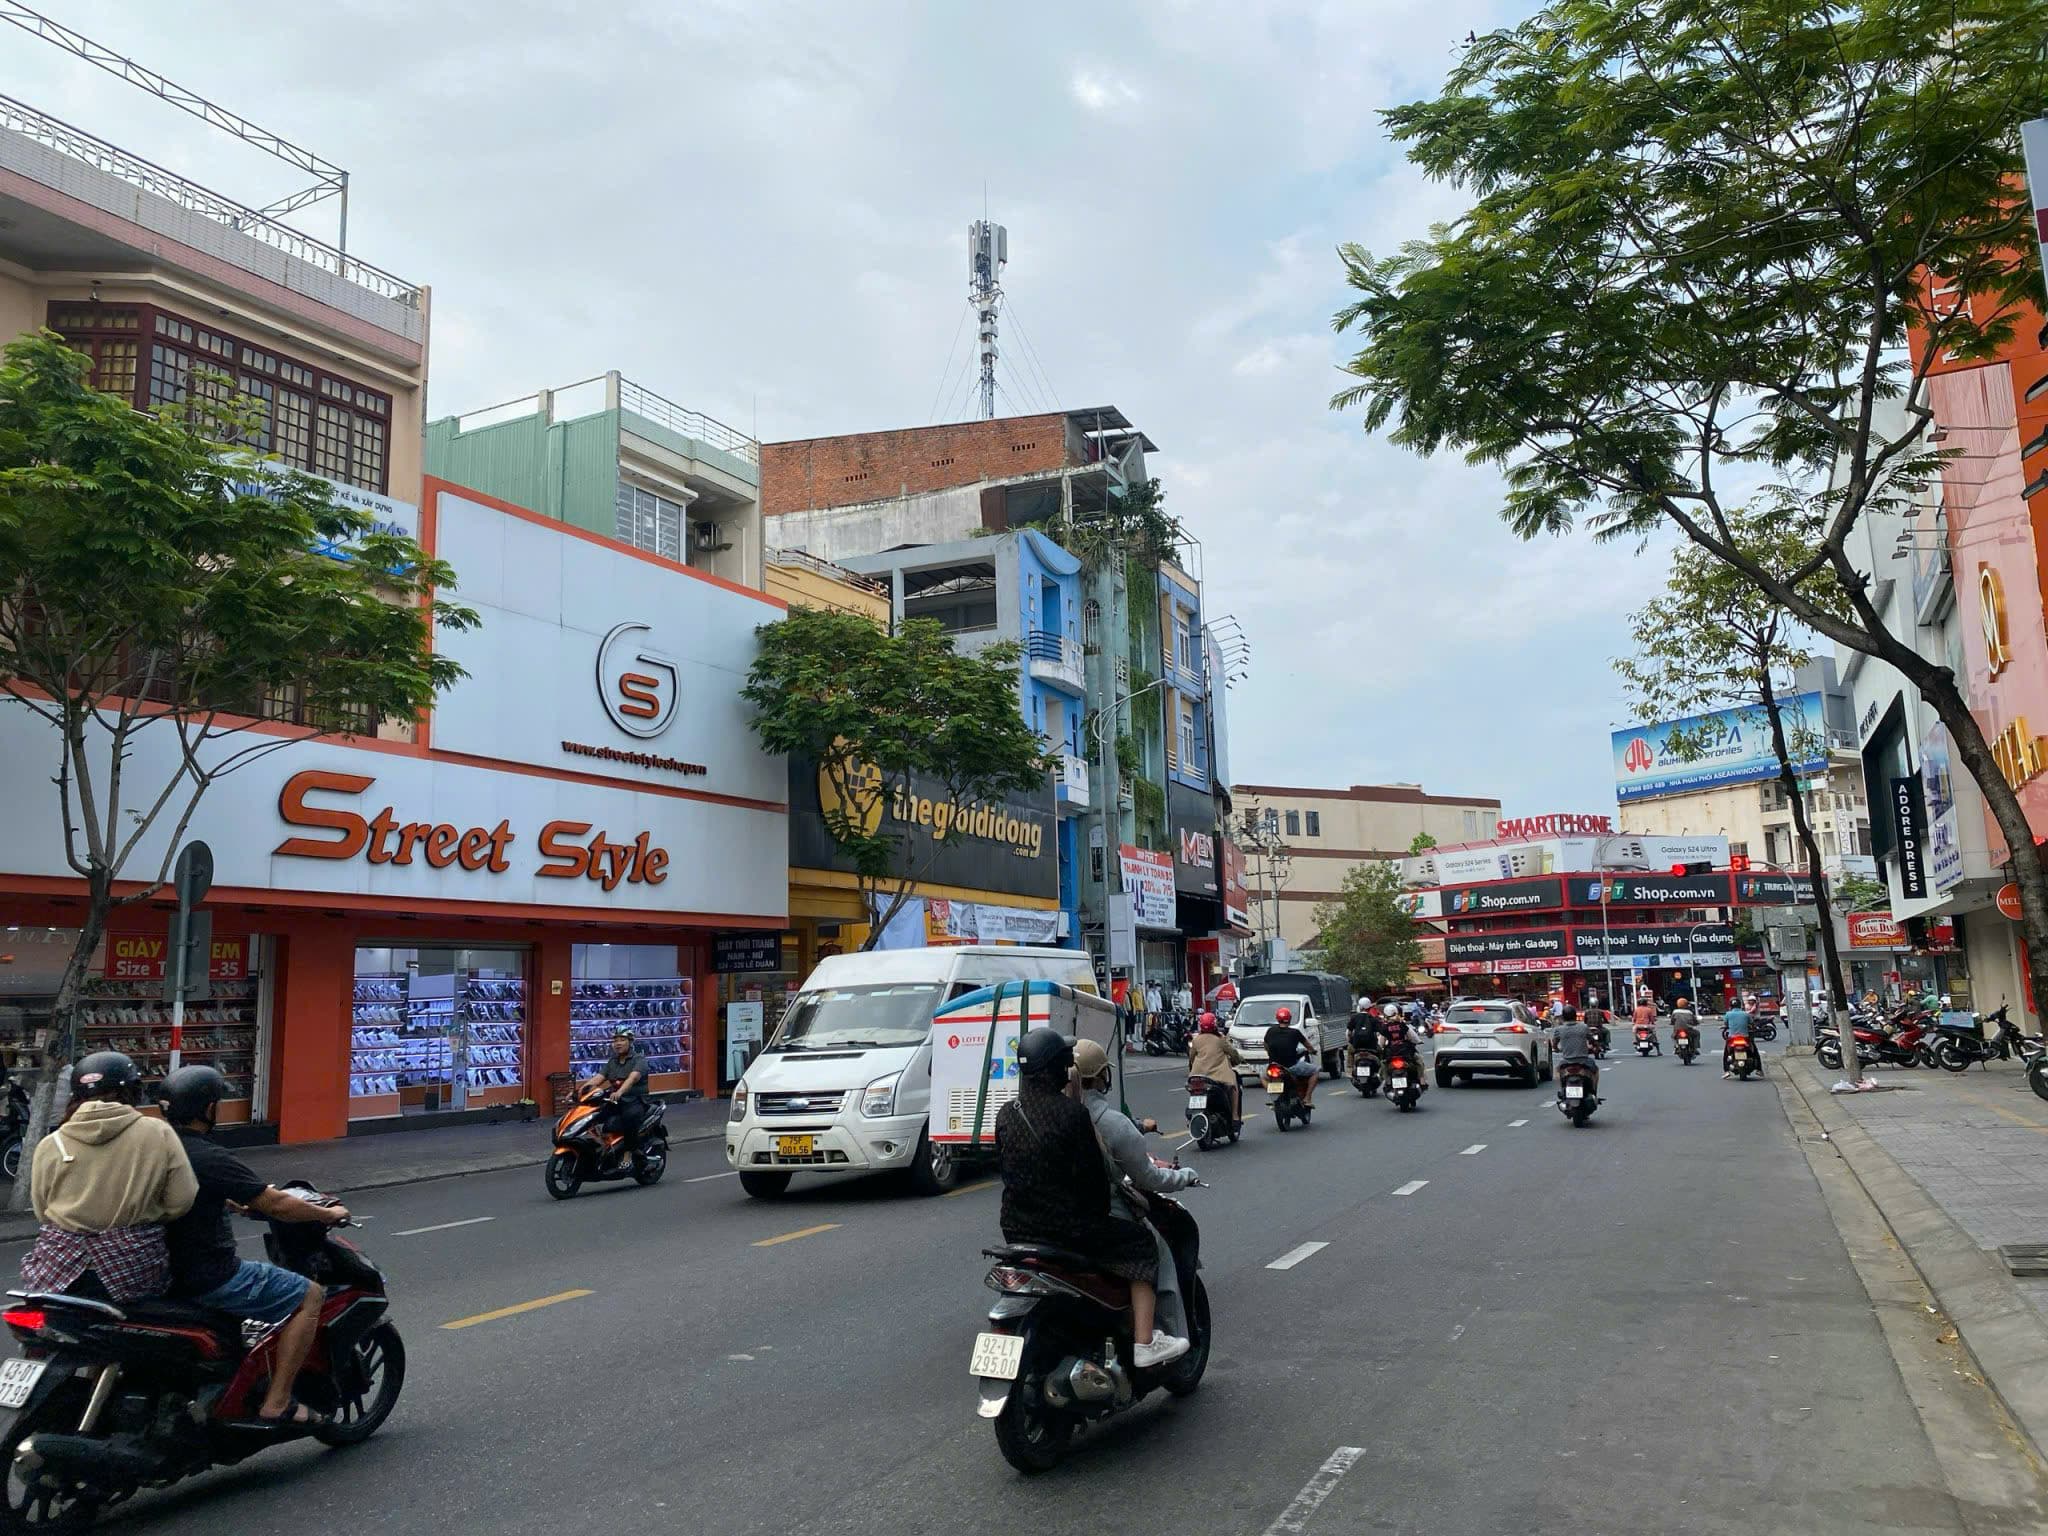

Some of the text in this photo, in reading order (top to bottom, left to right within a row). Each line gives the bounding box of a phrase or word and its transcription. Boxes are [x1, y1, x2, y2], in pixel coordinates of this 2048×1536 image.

[271, 769, 669, 891] Street Style
[1497, 813, 1612, 838] SMARTPHONE
[1898, 784, 1919, 892] ADORE DRESS
[1661, 846, 1686, 854] Galaxy
[1701, 845, 1717, 853] Ultra
[1588, 878, 1715, 903] FPT Shop.com.vn
[1481, 894, 1541, 909] Shop.com.vn
[116, 937, 240, 959] GIÀY EM
[1450, 943, 1466, 954] Điện
[1467, 942, 1485, 953] thoại
[1489, 941, 1504, 951] Máy
[1506, 940, 1520, 950] tính
[1525, 940, 1537, 949] Gia
[1537, 939, 1558, 950] dụng
[1576, 935, 1600, 946] Điện
[1639, 934, 1659, 946] Máy
[1662, 933, 1682, 944] tính
[1692, 933, 1708, 943] Gia
[1709, 933, 1734, 944] dụng
[116, 961, 149, 976] Size
[973, 1356, 1017, 1376] 295.00
